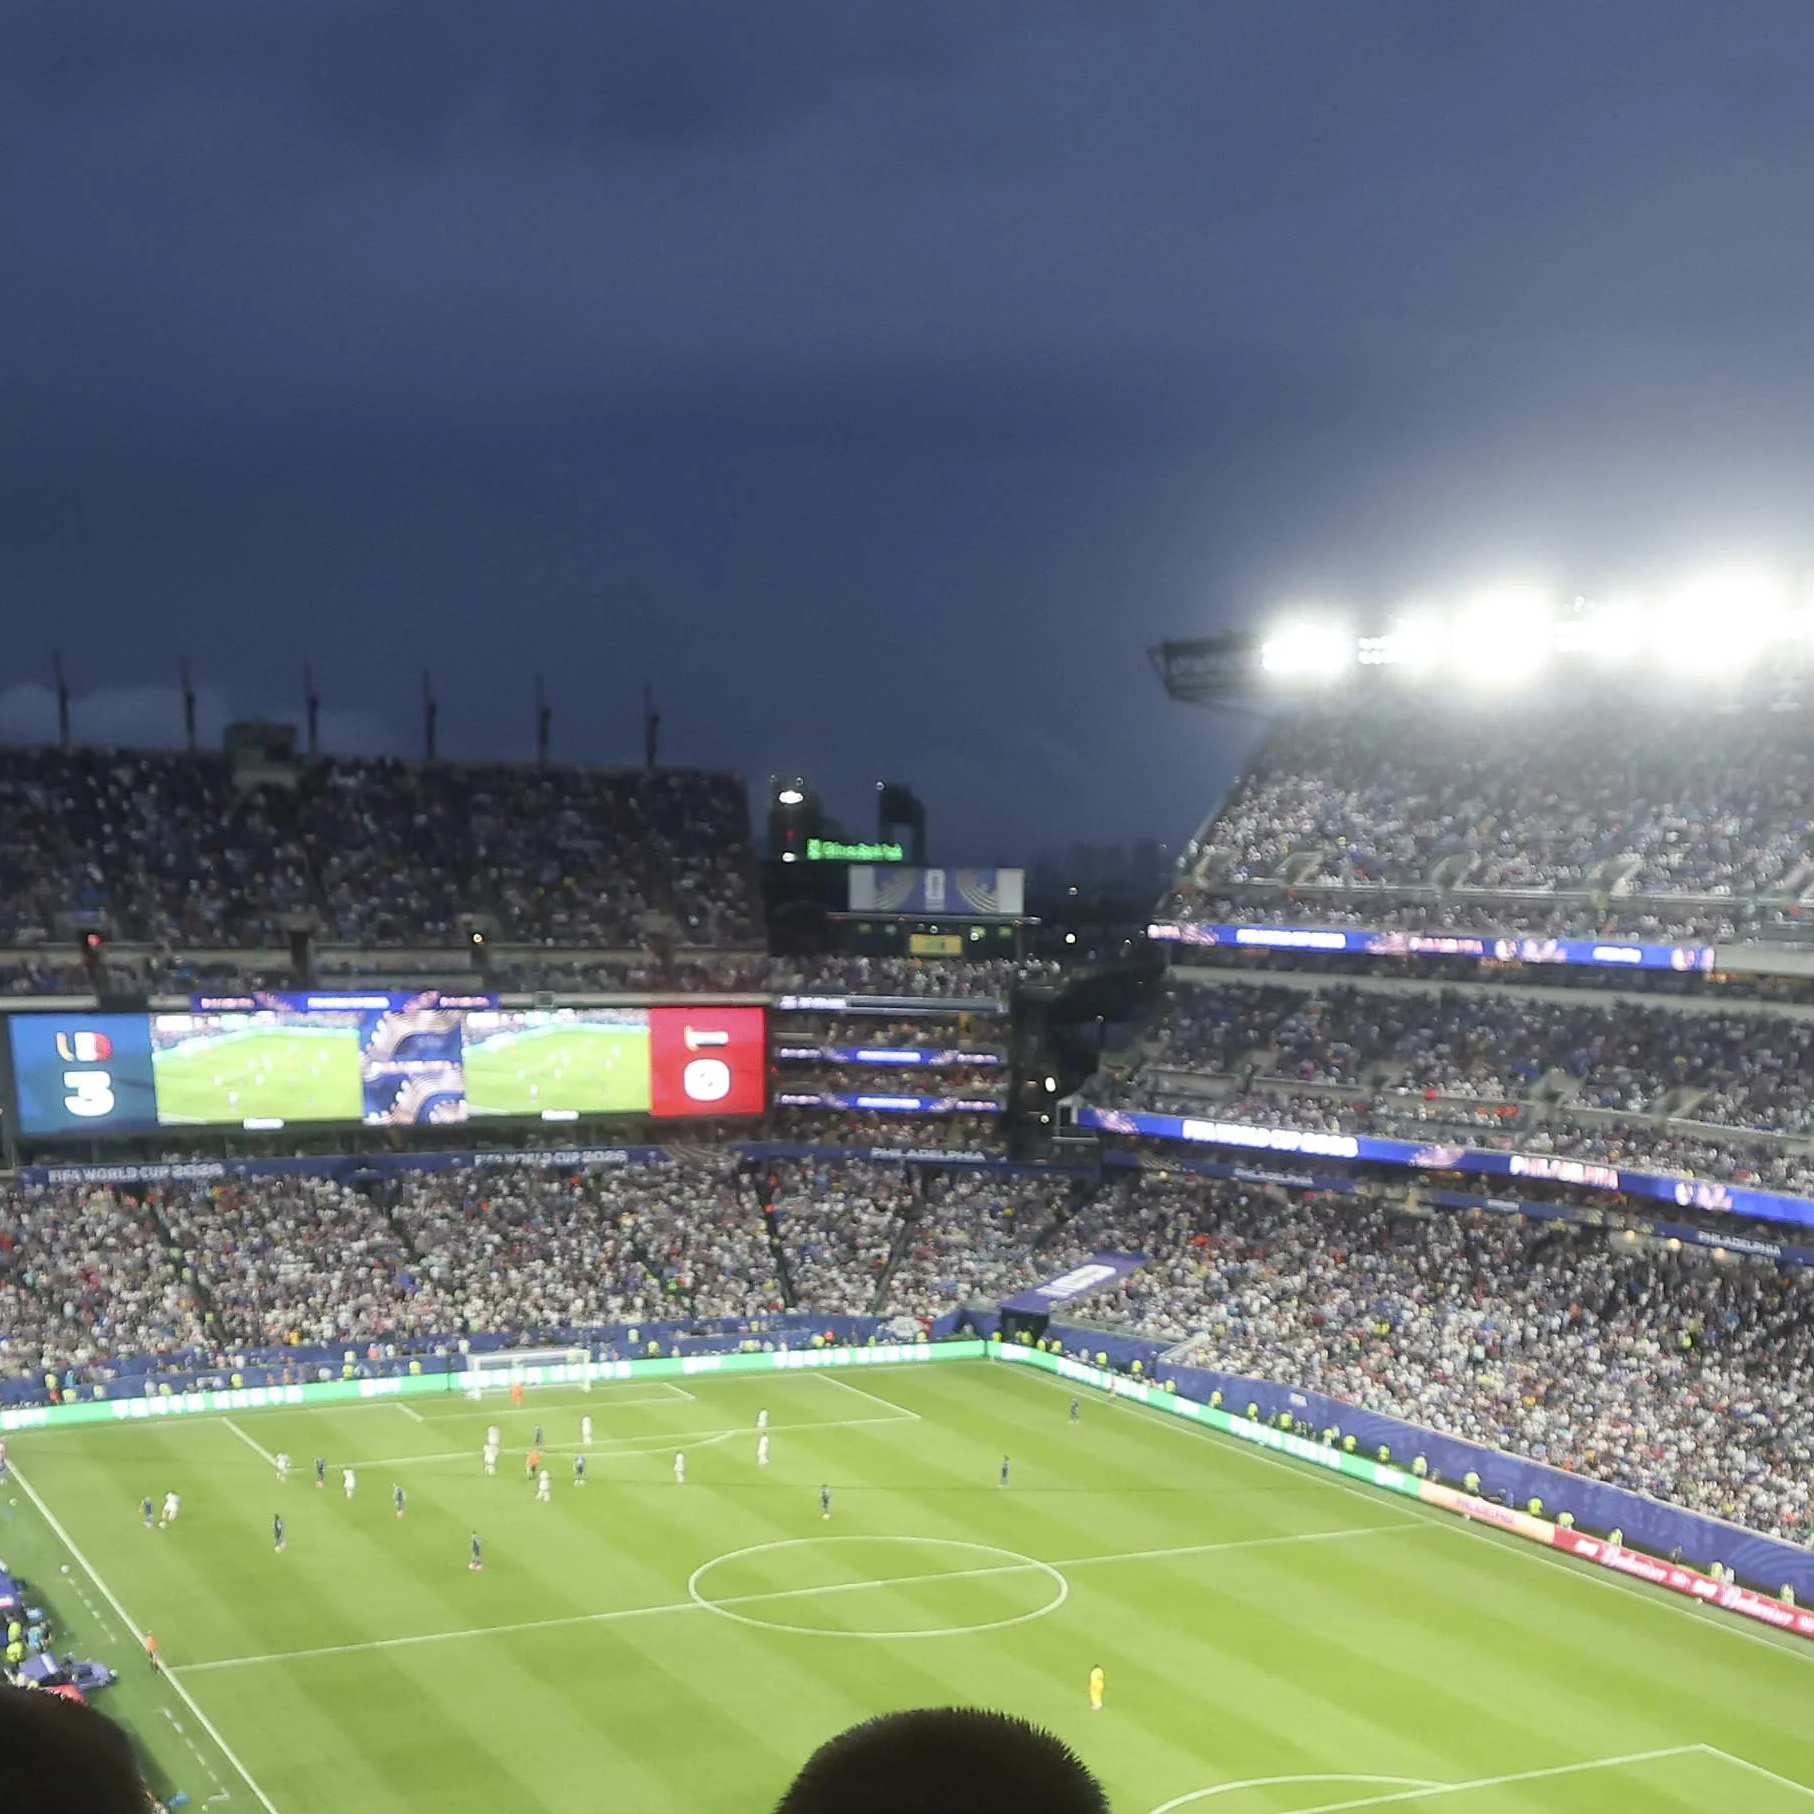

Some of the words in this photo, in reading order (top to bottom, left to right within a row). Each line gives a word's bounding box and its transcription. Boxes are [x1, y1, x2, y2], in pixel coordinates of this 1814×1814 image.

[63, 1070, 116, 1117] 3
[553, 1152, 581, 1165] CUP
[48, 1169, 82, 1183] FIFA
[83, 1167, 138, 1183] WORLD
[139, 1165, 170, 1181] CUP
[1697, 1230, 1782, 1257] PHILADELPHIA
[1719, 1584, 1795, 1627] Budweiser
